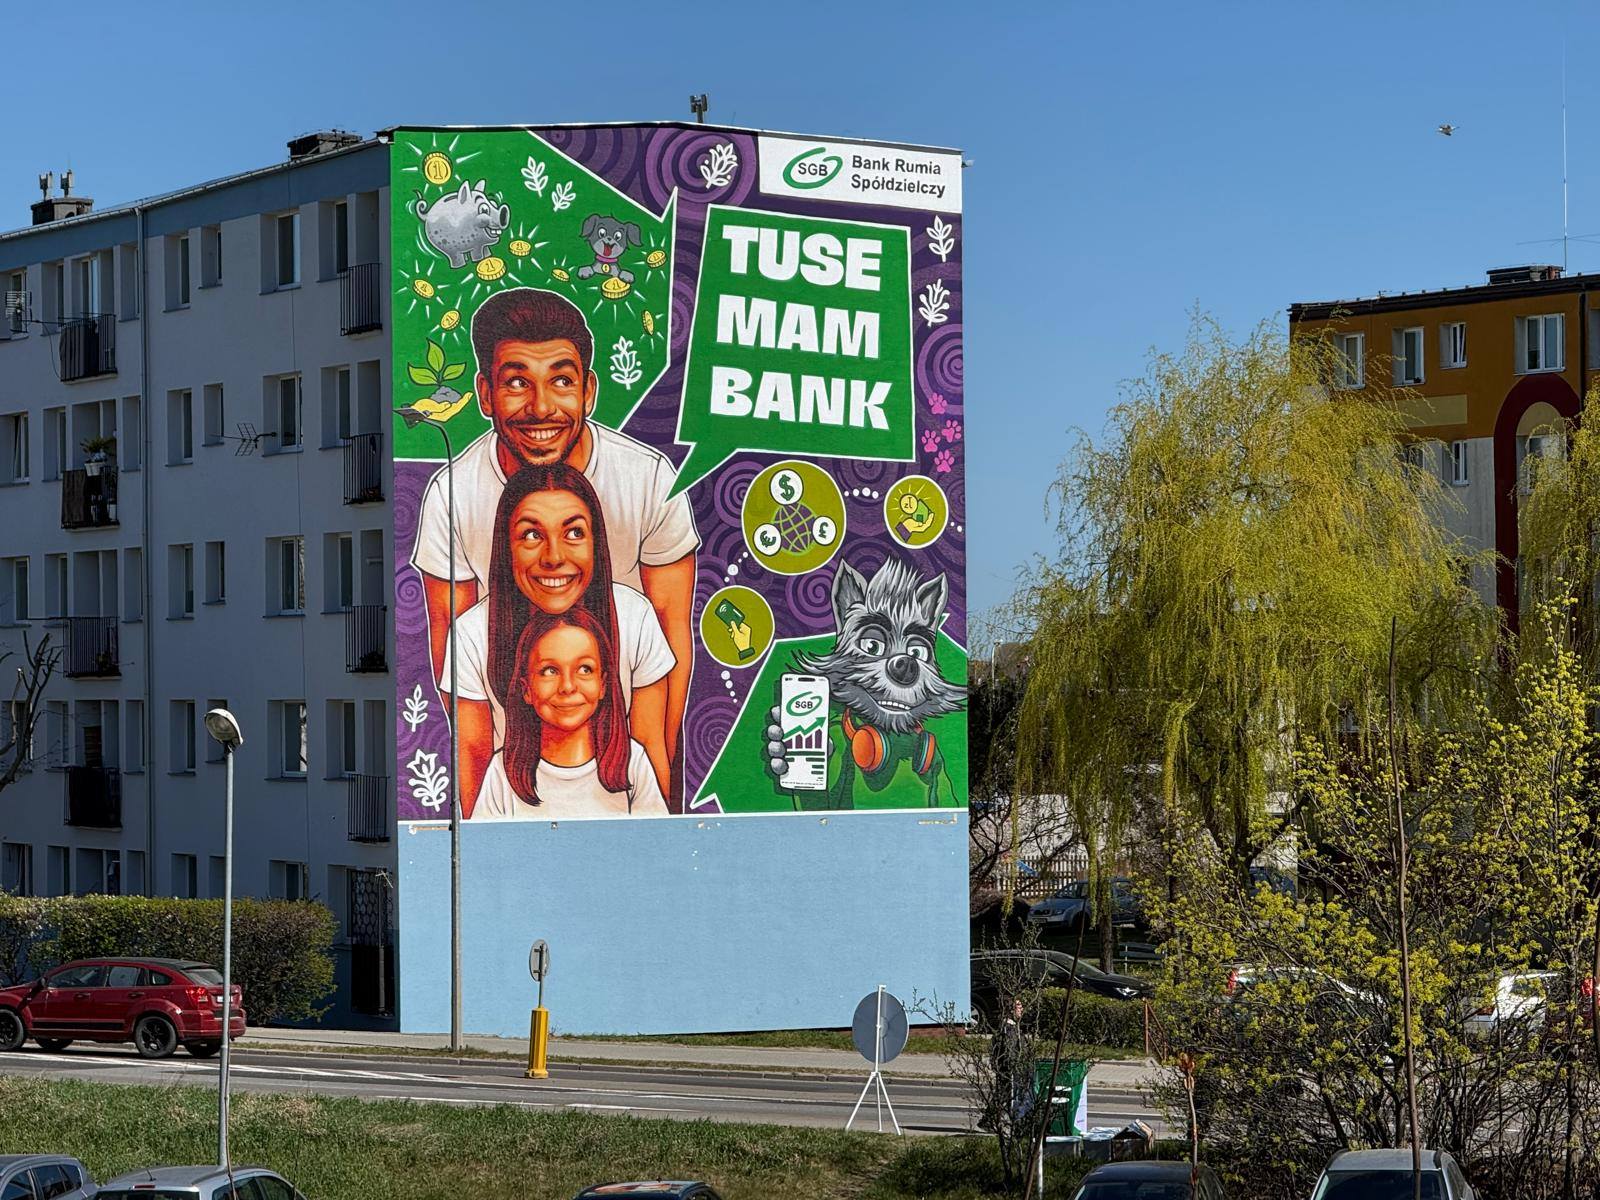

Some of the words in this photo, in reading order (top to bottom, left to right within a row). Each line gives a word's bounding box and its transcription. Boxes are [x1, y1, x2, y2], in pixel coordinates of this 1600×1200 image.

[798, 162, 828, 177] SGB
[852, 155, 890, 172] Bank
[895, 158, 941, 175] Rumia
[851, 174, 946, 199] Spółdzielczy
[722, 224, 883, 292] TUSE
[716, 294, 880, 359] MAM
[710, 366, 893, 431] BANK
[778, 474, 795, 501] $
[795, 700, 813, 710] SGB
